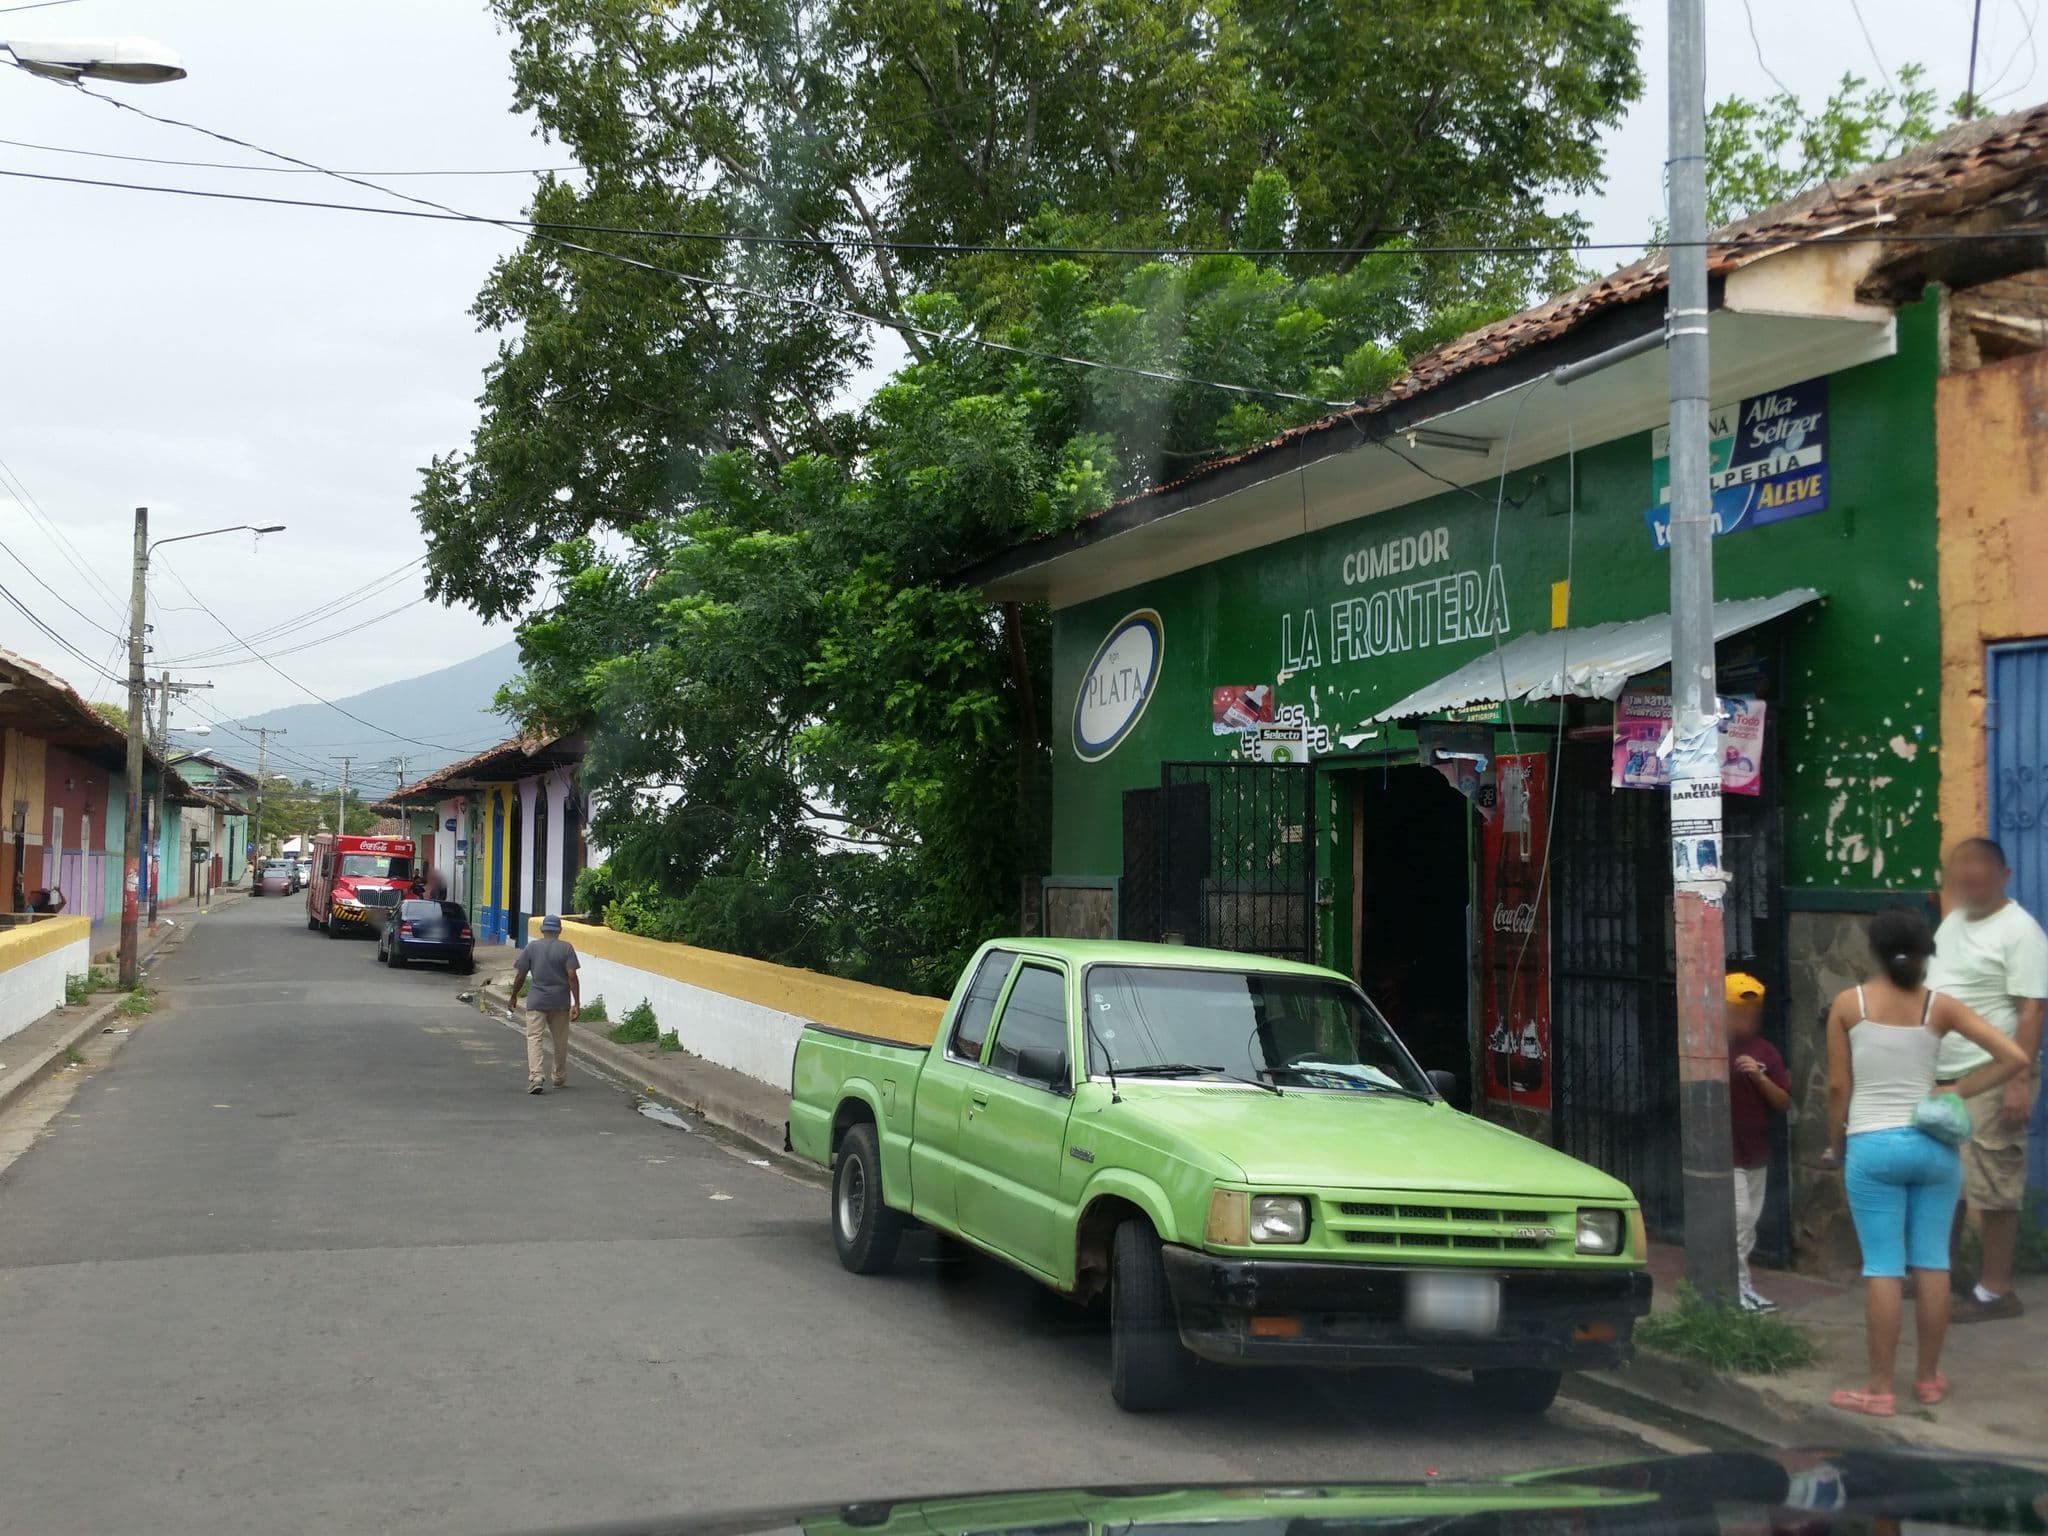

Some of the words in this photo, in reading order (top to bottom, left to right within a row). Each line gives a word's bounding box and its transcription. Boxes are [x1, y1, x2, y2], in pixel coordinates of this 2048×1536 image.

[1745, 395, 1797, 426] Alka-
[1750, 411, 1822, 449] Seltzer
[1756, 474, 1822, 511] ALEVE
[1343, 527, 1449, 585] COMEDOR
[1281, 608, 1321, 673] LA
[1330, 564, 1510, 664] FRONTERA
[1088, 668, 1145, 709] PLATA
[1262, 729, 1301, 740] Selecto
